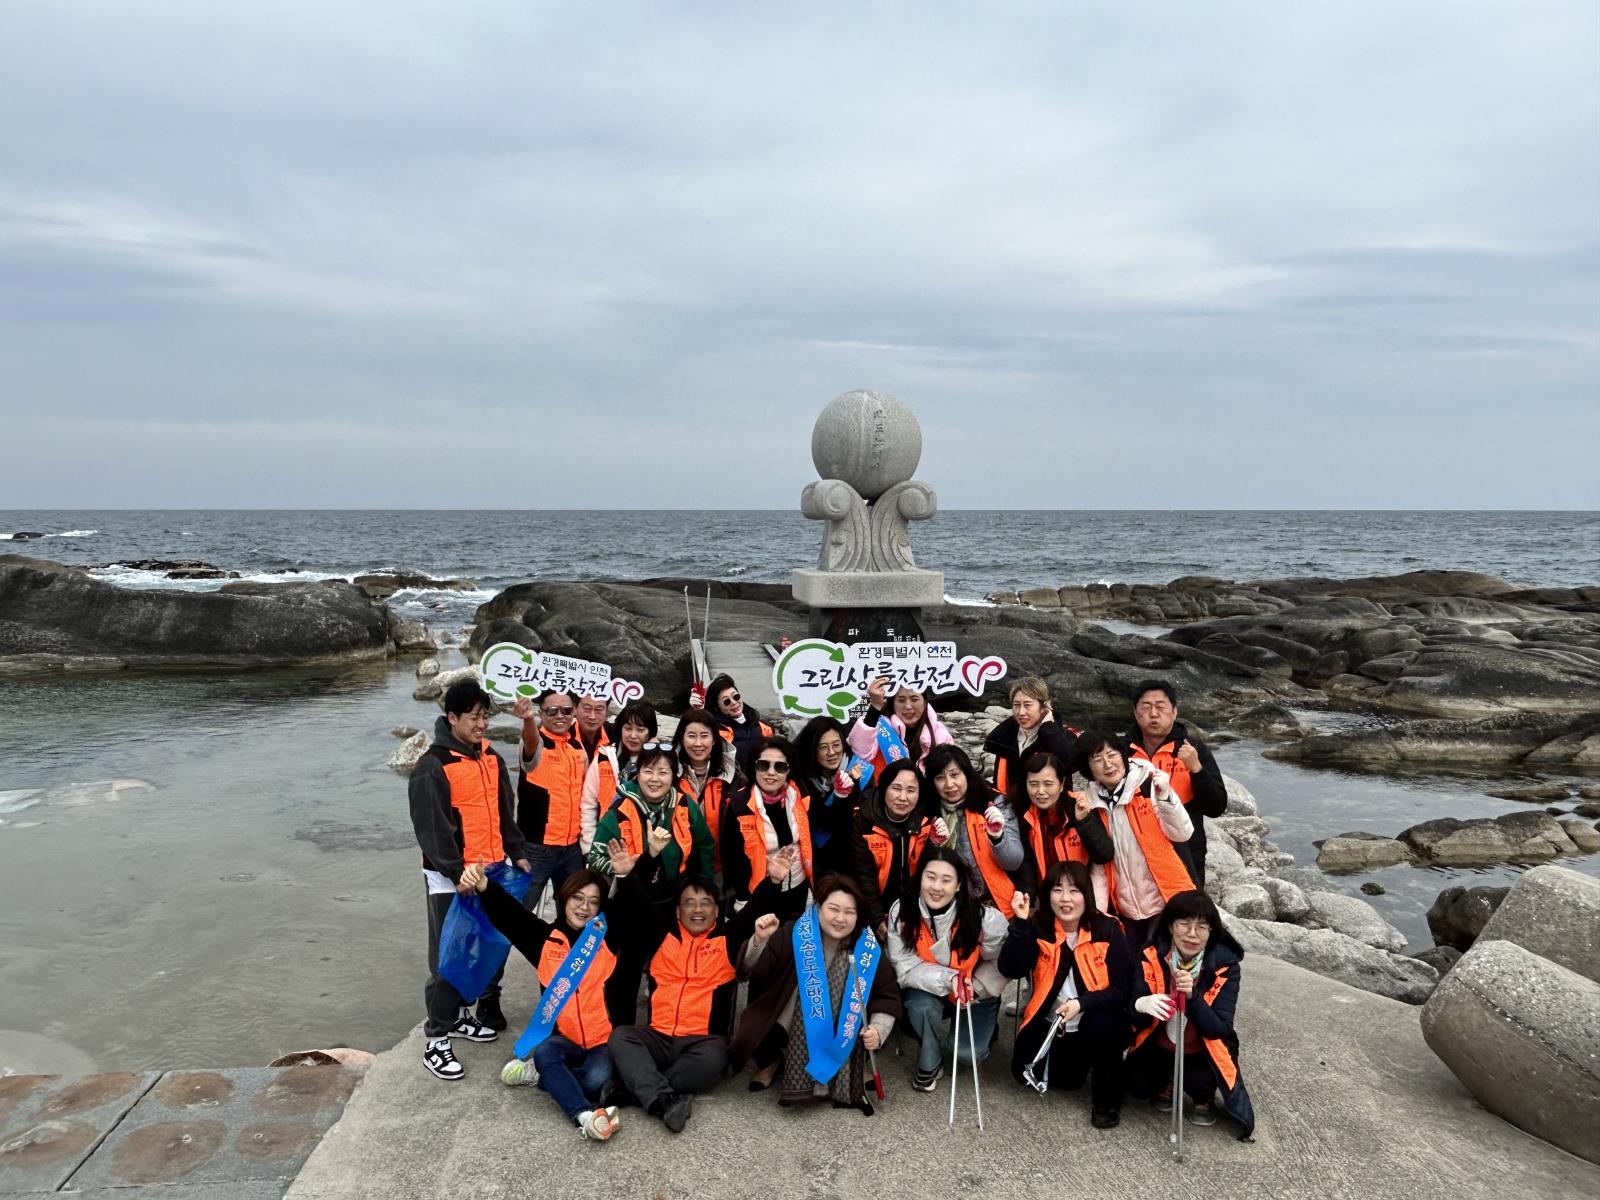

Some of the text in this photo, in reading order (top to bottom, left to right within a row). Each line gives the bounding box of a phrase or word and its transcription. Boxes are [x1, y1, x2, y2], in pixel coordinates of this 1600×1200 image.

[858, 646, 921, 659] 환경특별시
[497, 663, 609, 698] 그린상륙작전
[799, 661, 955, 692] 그린상륙작전
